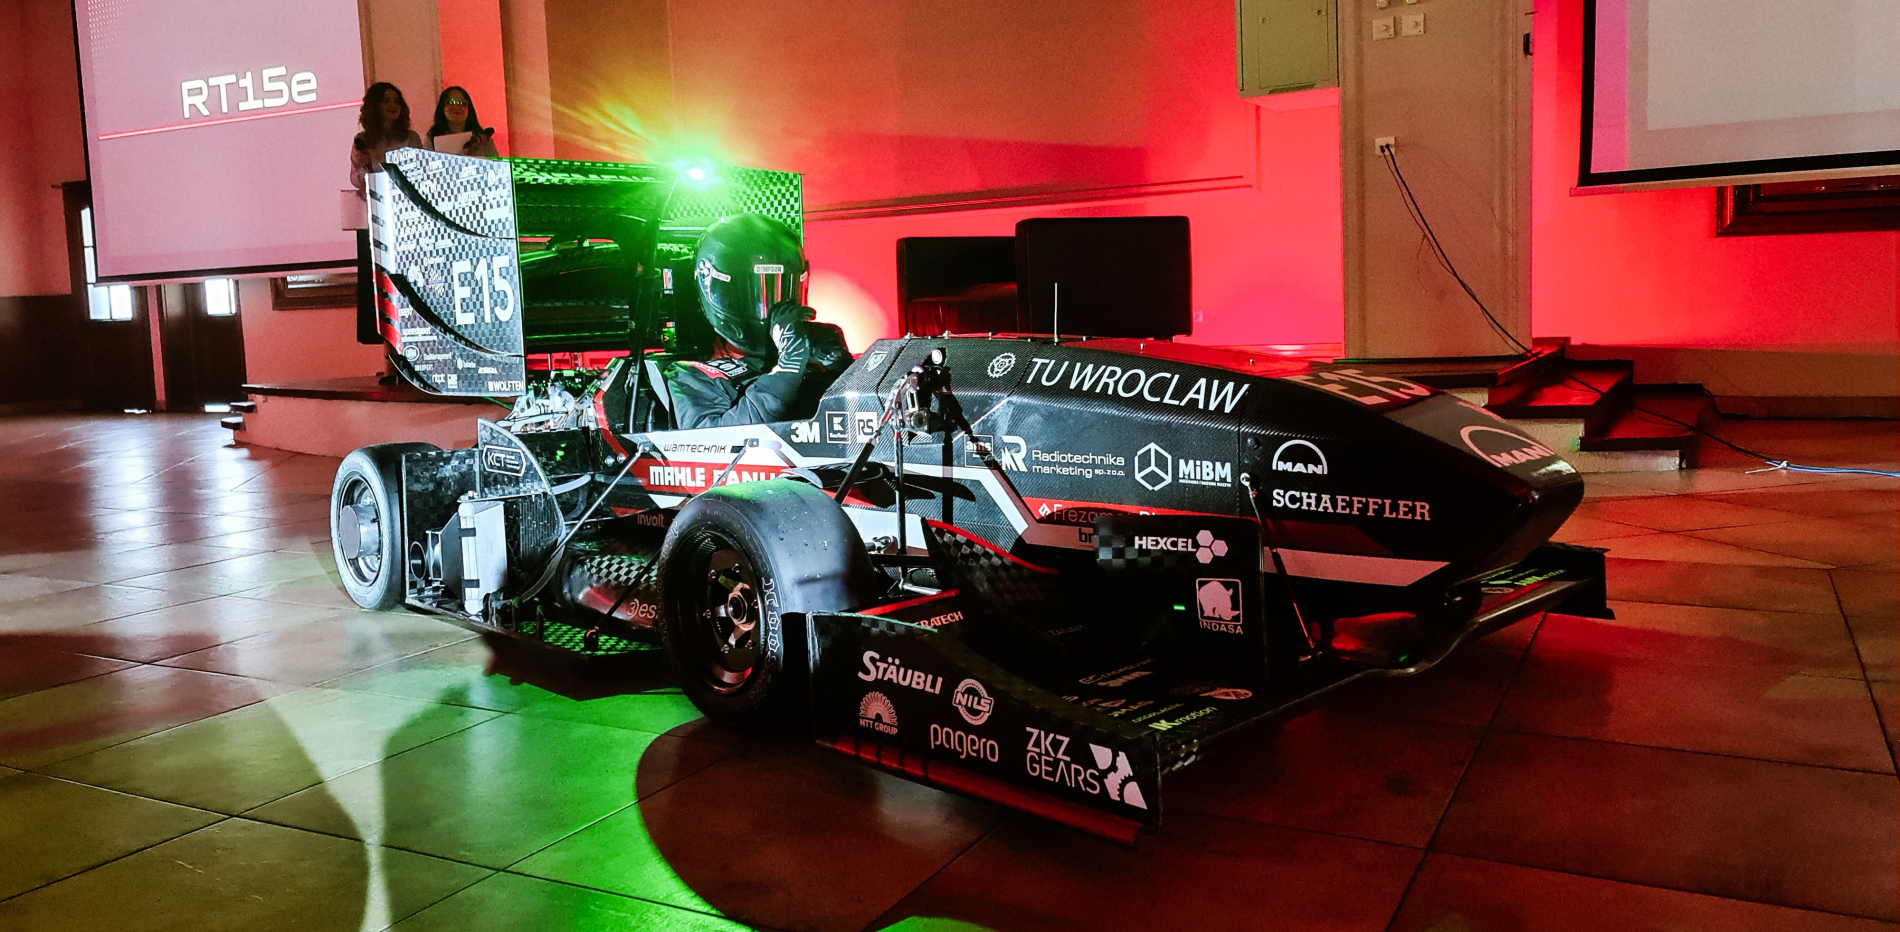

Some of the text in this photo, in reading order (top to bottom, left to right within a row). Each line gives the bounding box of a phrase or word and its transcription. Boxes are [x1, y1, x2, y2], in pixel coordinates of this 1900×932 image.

[181, 66, 318, 119] RT15e
[452, 255, 514, 326] E15
[493, 380, 524, 392] WOLFTEN
[1026, 357, 1250, 414] TU WROCLAW
[1280, 369, 1430, 405] E15
[790, 421, 821, 444] 3M
[1032, 450, 1125, 466] Radiotechnika
[1277, 461, 1324, 474] MAN
[1494, 446, 1551, 467] MAN
[650, 465, 706, 487] MAHLE
[1032, 465, 1093, 479] marketing
[1178, 458, 1232, 482] MiBM
[1272, 489, 1431, 521] SCHAEFFLER
[1134, 536, 1197, 552] HEXCEL
[1200, 621, 1243, 635] INDASA
[857, 650, 943, 695] STÄUBLI
[955, 692, 992, 713] NILS
[860, 718, 898, 736] NTT GROUP
[930, 723, 999, 763] pagero
[1026, 726, 1072, 762] ZKZ
[1026, 753, 1101, 795] GEARS
